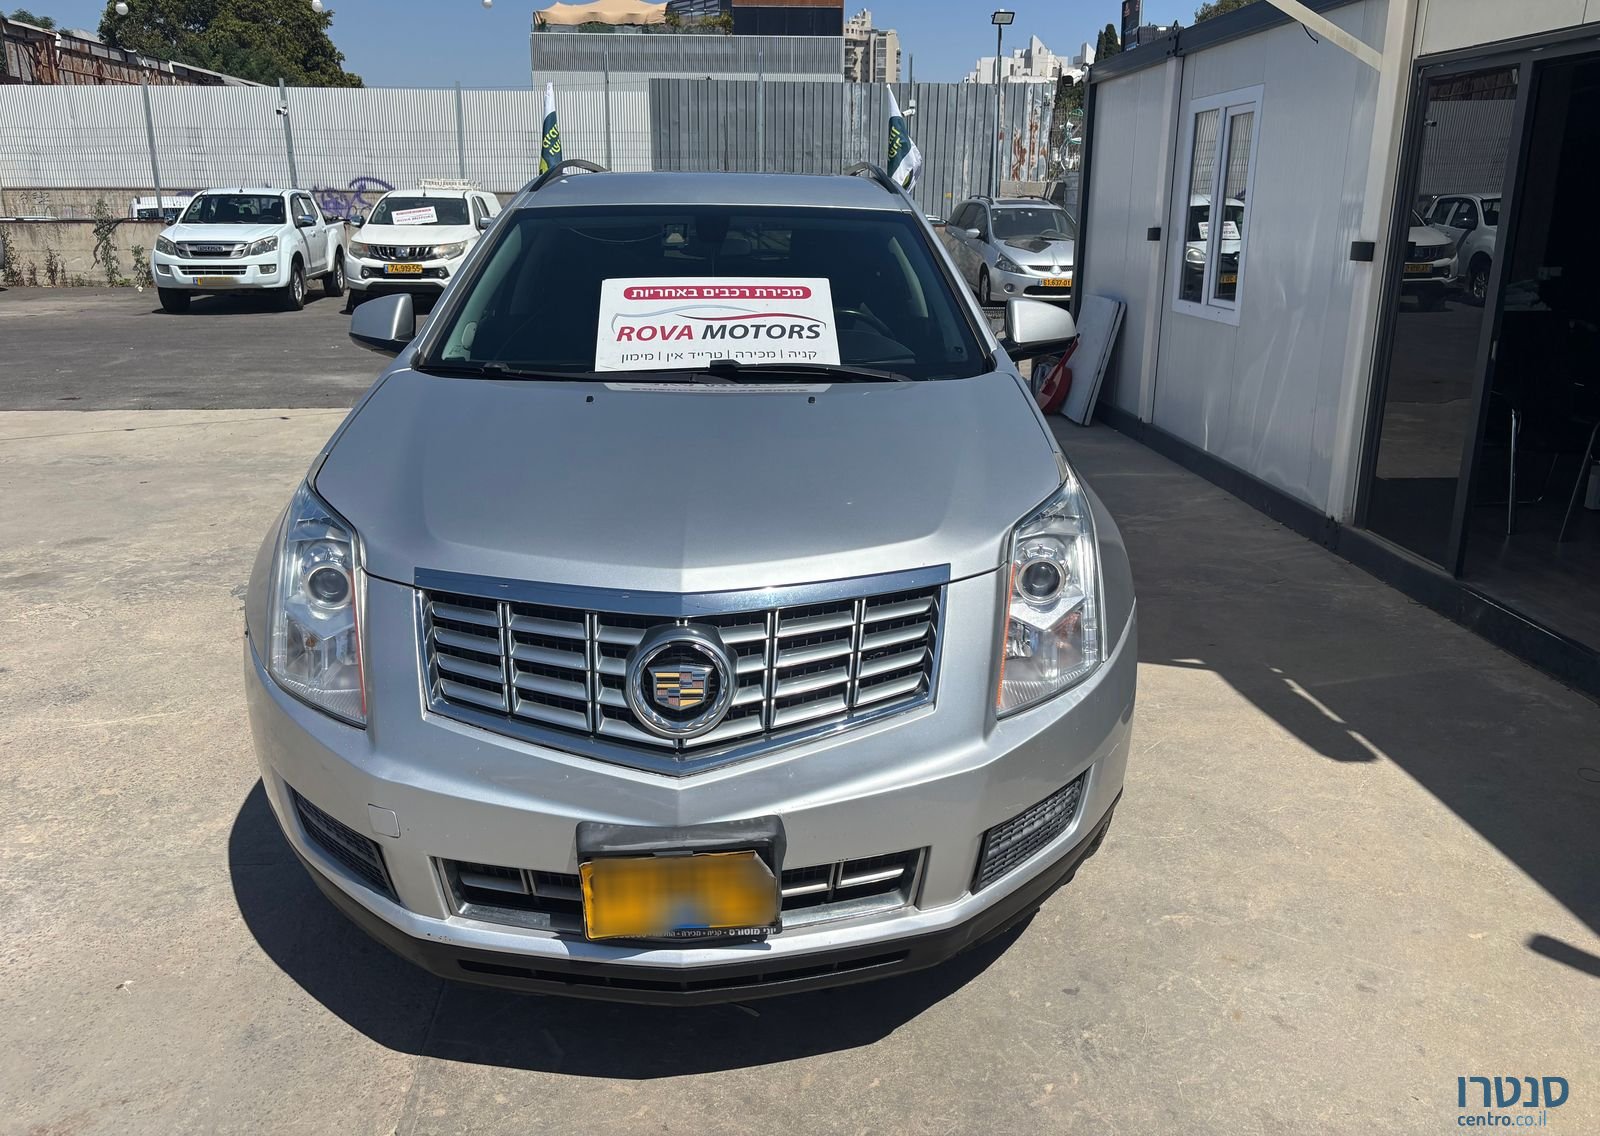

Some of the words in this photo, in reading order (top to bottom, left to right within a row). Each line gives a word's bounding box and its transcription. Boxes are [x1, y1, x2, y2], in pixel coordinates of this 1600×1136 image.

[630, 288, 699, 299] באחריות
[703, 288, 749, 298] רכבים
[755, 287, 804, 298] מכירת
[616, 325, 694, 342] ROVA
[701, 324, 821, 340] MOTORS
[621, 352, 654, 363] מימון
[666, 352, 684, 362] אין
[688, 350, 723, 360] טרייד
[735, 350, 776, 360] מכירה
[788, 350, 818, 360] קניה
